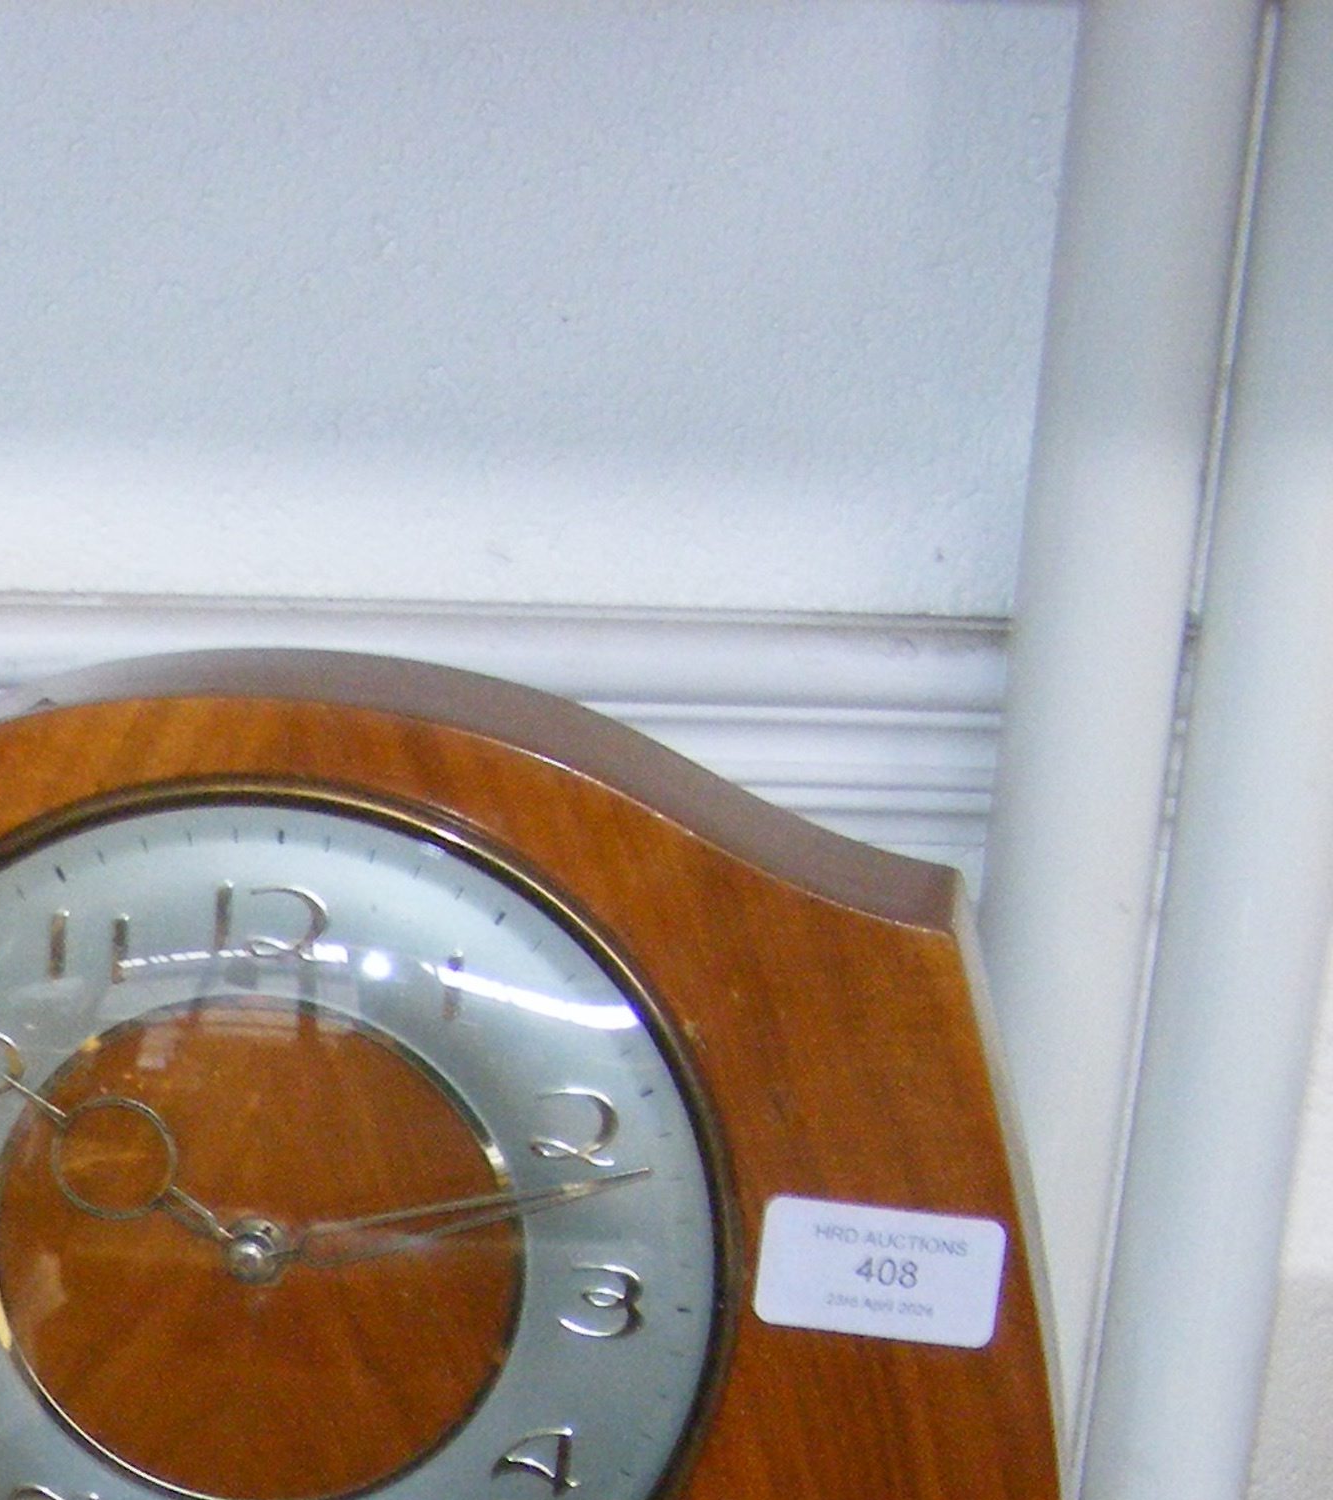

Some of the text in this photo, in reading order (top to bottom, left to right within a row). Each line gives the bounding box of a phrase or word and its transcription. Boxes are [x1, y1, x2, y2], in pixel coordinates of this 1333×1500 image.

[47, 908, 131, 985] 11
[214, 879, 331, 962] 12
[532, 1086, 619, 1169] 2
[855, 1256, 918, 1289] 408
[865, 1231, 968, 1256] AUCTIONS
[558, 1261, 643, 1339] 3
[493, 1426, 580, 1497] 4
